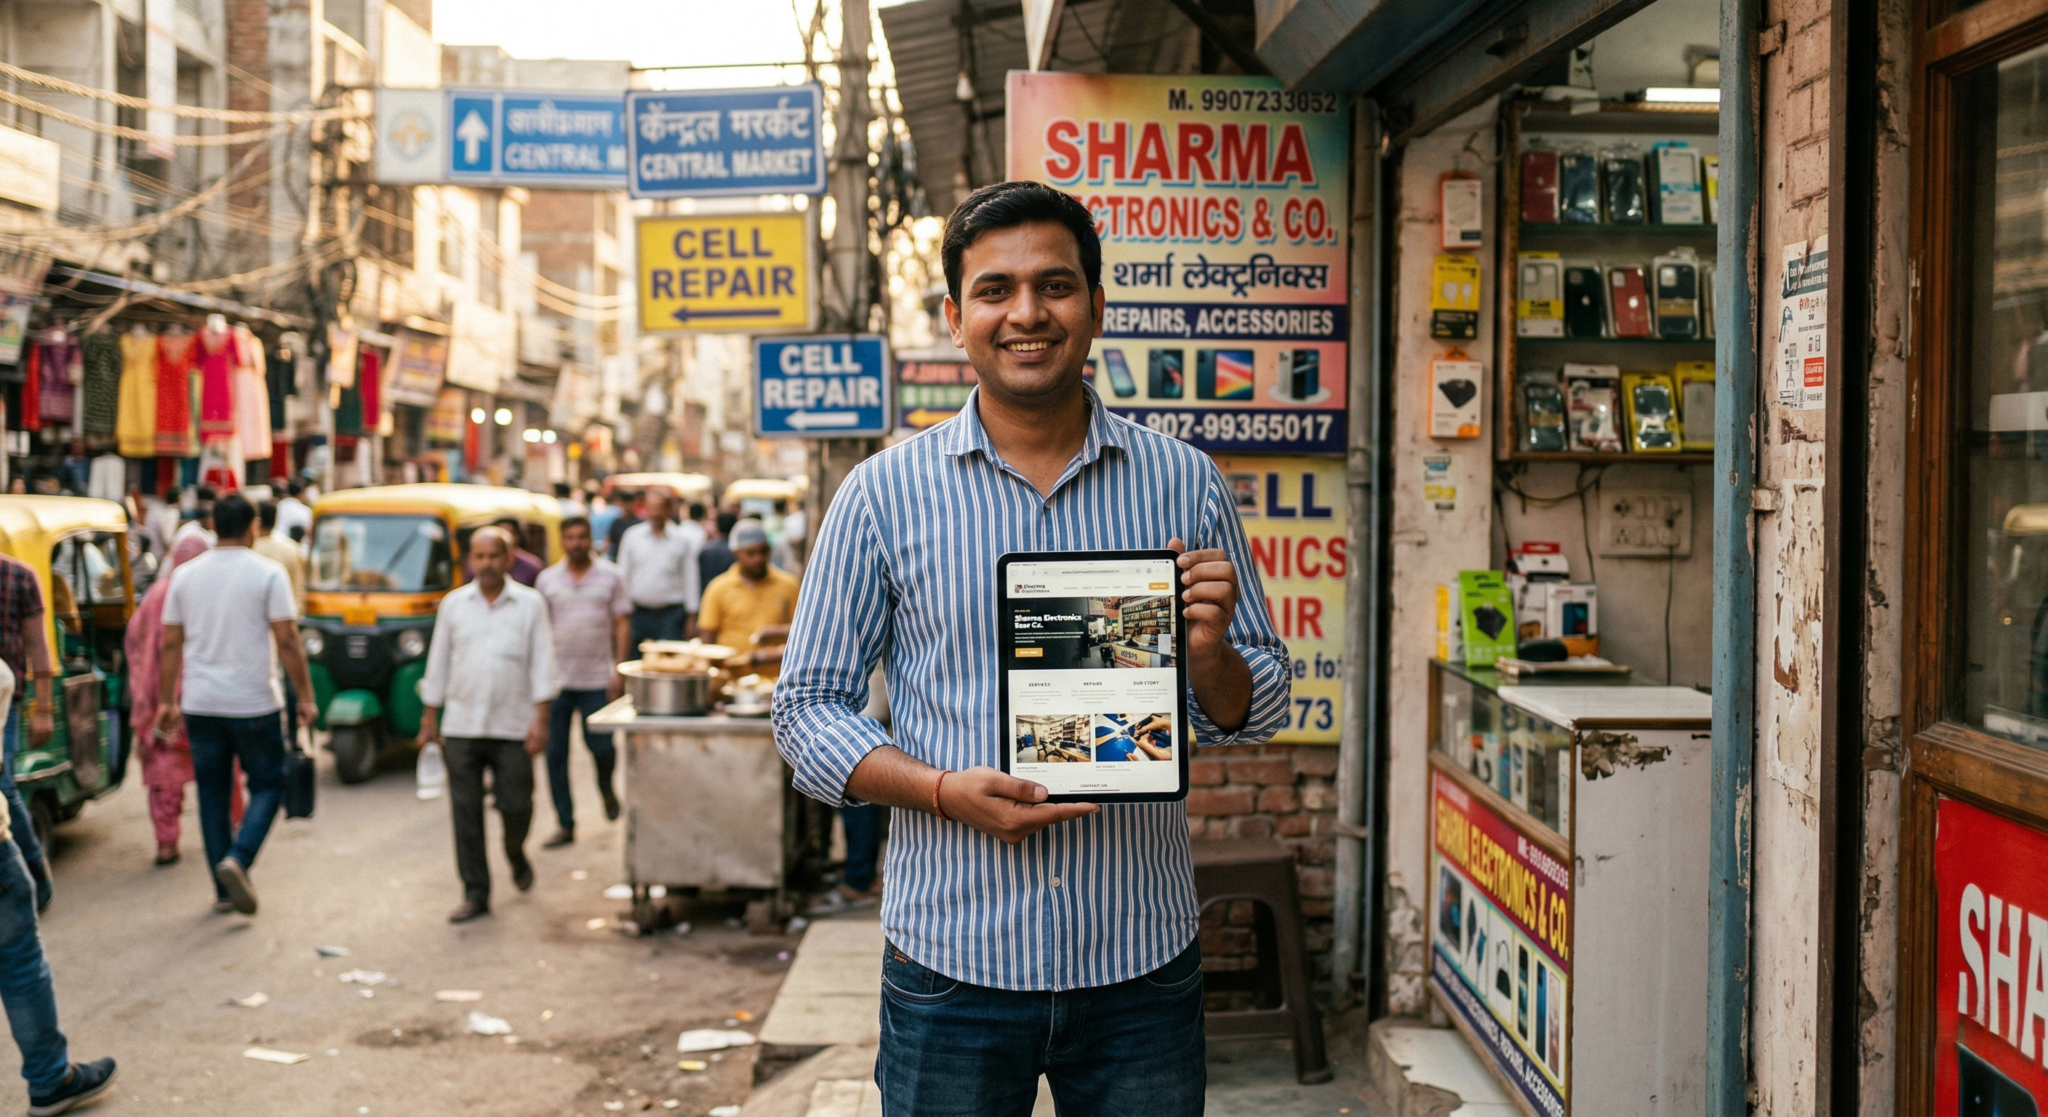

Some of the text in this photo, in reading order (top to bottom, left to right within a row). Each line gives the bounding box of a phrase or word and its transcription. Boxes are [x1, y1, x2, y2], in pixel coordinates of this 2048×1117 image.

[1168, 88, 1194, 111] M.
[504, 141, 604, 171] CENTRAL
[639, 148, 813, 182] CENTRAL MARKET
[1045, 119, 1316, 184] SHARMA
[1071, 195, 1334, 241] CTRONICS & CO.
[673, 227, 773, 260] CELL
[651, 265, 796, 300] REPAIR
[1102, 307, 1334, 338] REPAIRS, ACCESSORIES
[779, 343, 862, 375] CELL
[762, 376, 881, 409] REPAIR
[1280, 697, 1334, 730] 73
